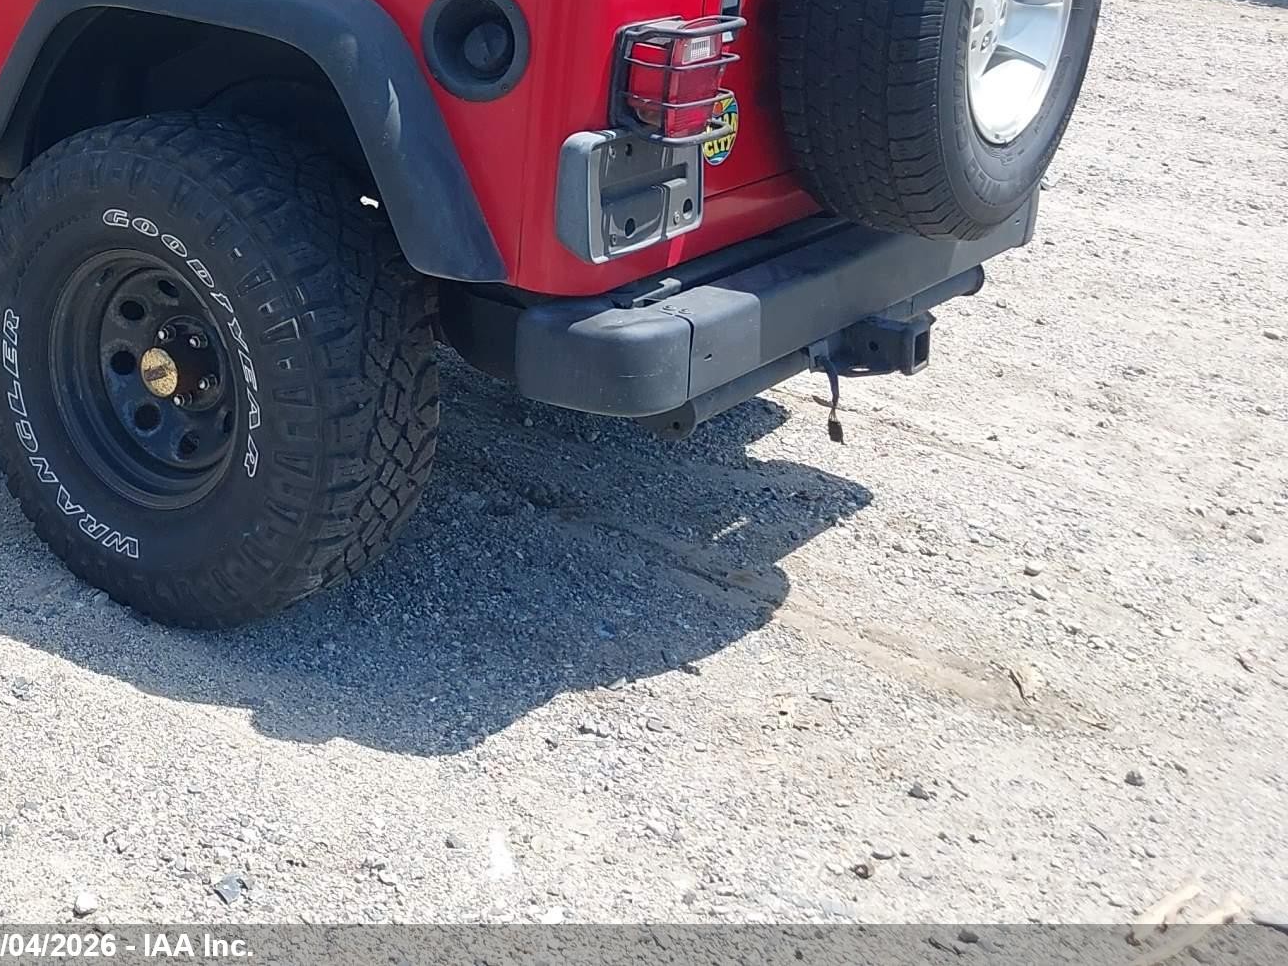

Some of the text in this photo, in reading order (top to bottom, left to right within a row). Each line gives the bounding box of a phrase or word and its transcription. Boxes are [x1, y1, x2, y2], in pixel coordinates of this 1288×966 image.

[704, 135, 735, 157] CITY
[2, 308, 141, 559] WRANGLER
[102, 208, 262, 478] GOODYEAR
